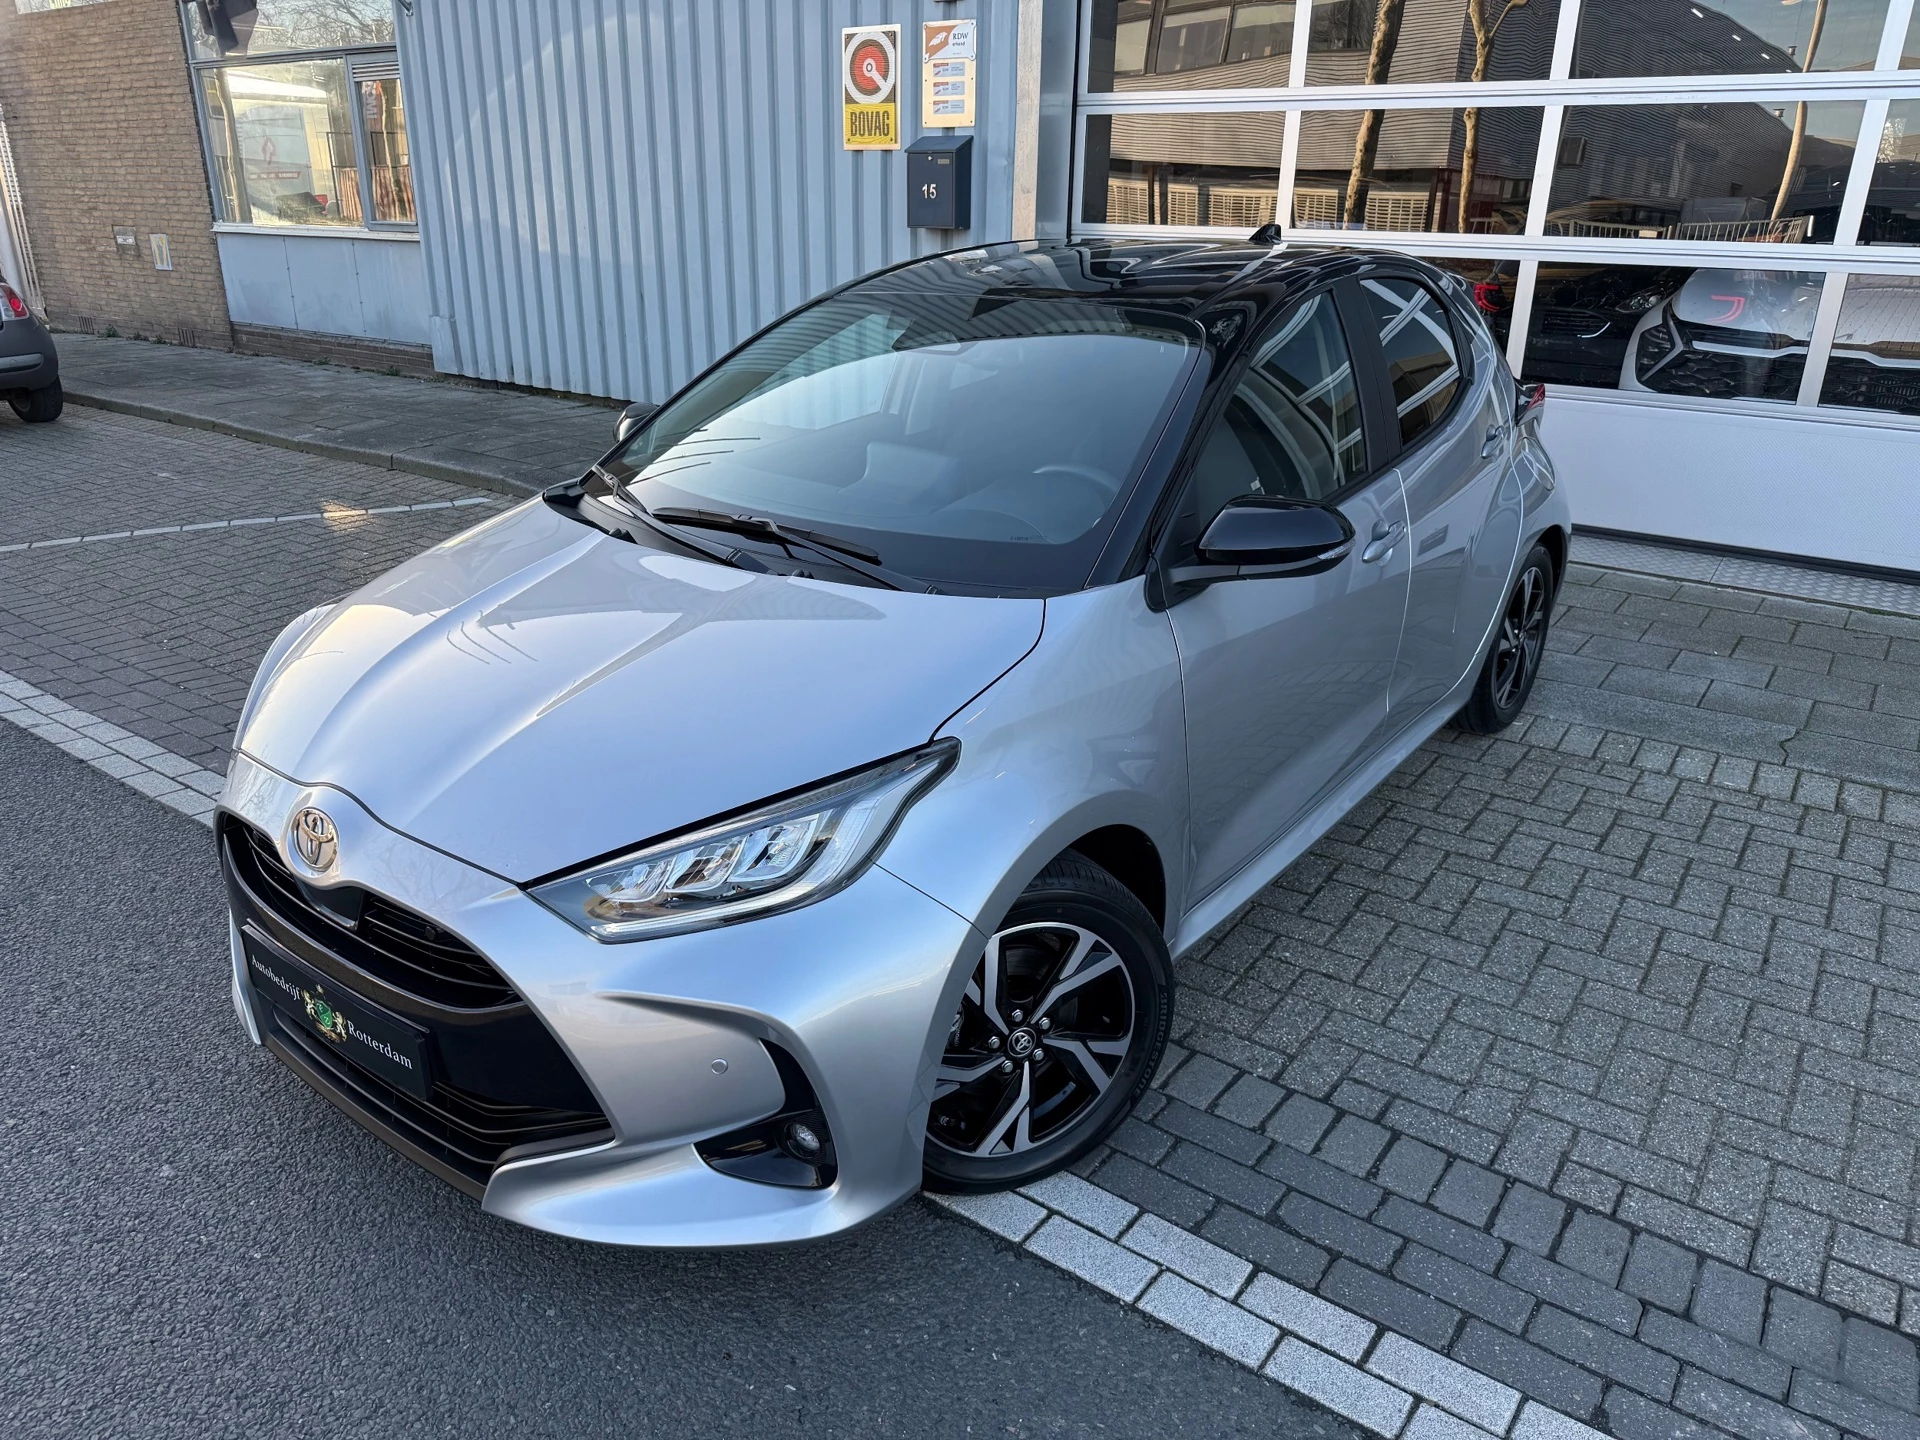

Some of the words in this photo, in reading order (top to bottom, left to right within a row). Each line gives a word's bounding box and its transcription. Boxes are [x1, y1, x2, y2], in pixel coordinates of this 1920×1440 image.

[952, 32, 969, 40] RDW
[850, 110, 890, 137] BOVAG
[922, 183, 937, 199] 15
[251, 955, 301, 1001] Autobedrijf
[346, 1019, 413, 1070] Rotterdam
[1133, 992, 1168, 1098] BRIDGESTONE
